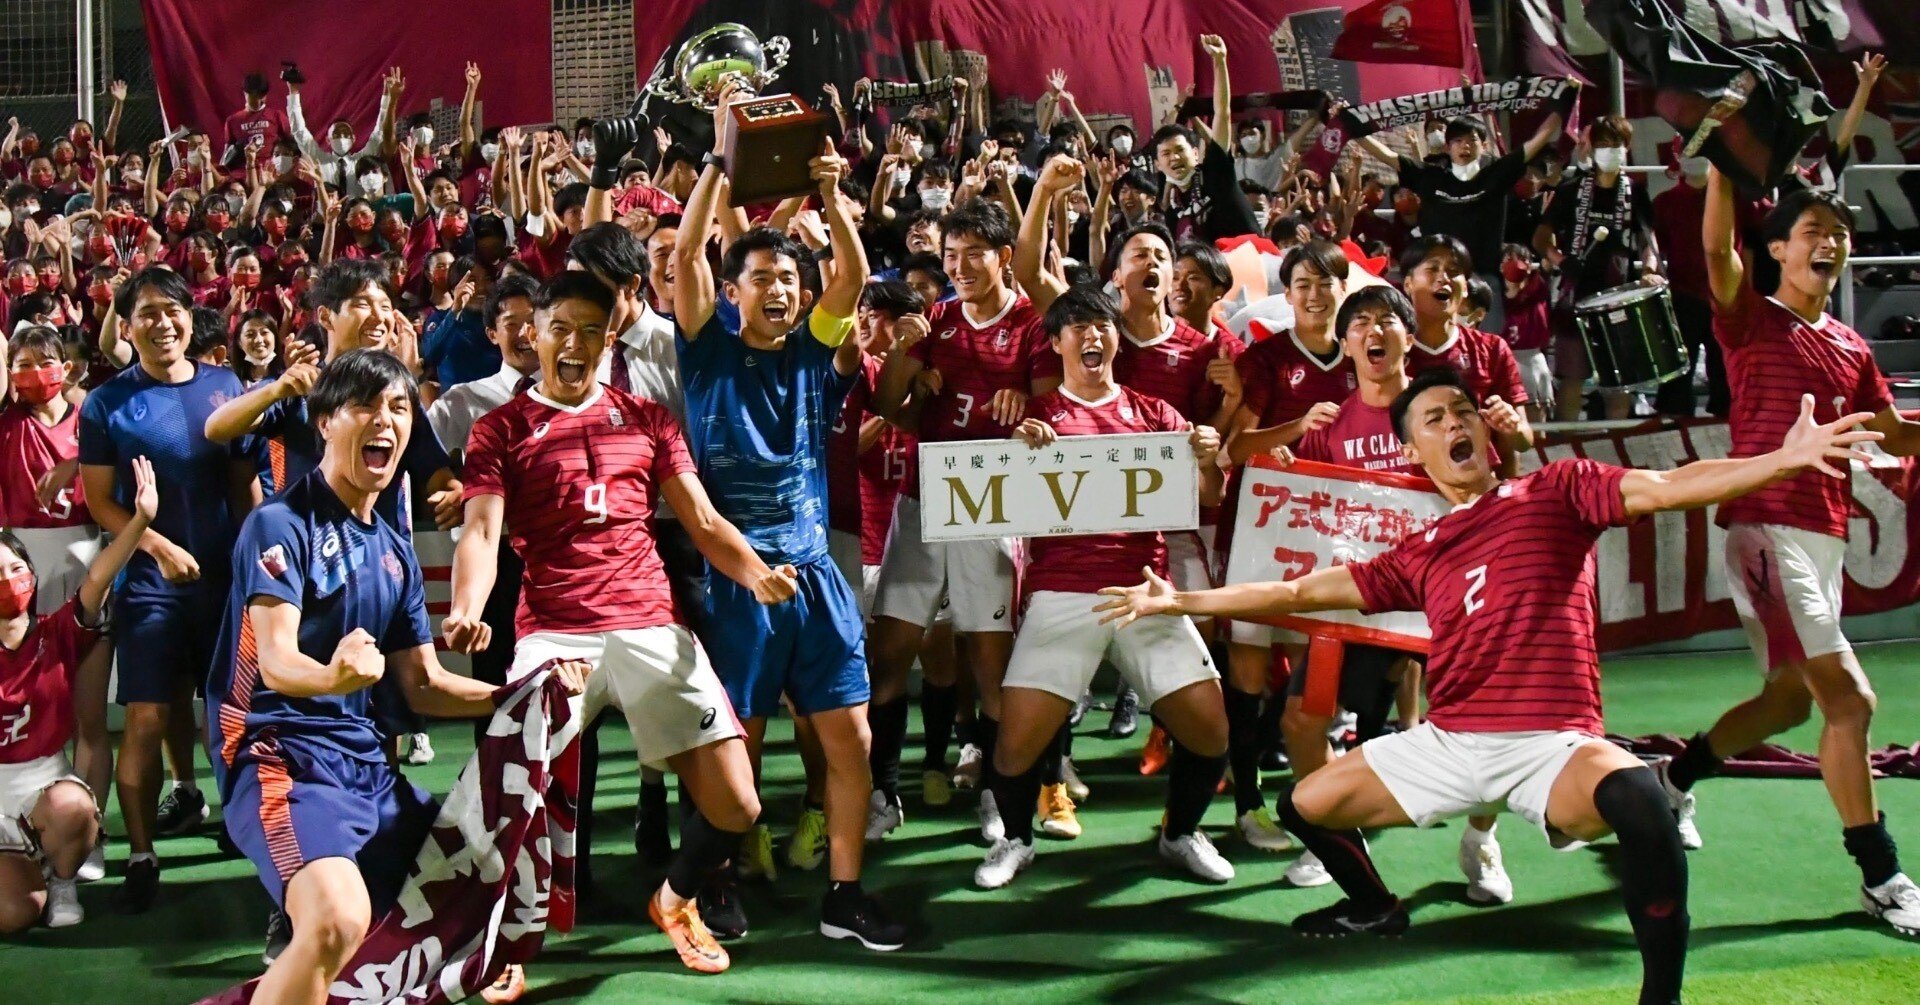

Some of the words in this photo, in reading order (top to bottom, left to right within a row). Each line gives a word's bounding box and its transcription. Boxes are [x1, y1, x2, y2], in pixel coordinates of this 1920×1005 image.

[1349, 88, 1465, 123] WASEDA
[1472, 80, 1520, 101] the
[1526, 76, 1568, 100] 1st
[1376, 112, 1427, 129] WASEDA
[953, 393, 974, 428] 3
[883, 447, 906, 480] 15
[944, 446, 1175, 469] 早慶サッカー定期戦
[1343, 437, 1366, 460] WK
[583, 483, 607, 524] 9
[1464, 565, 1487, 616] 2
